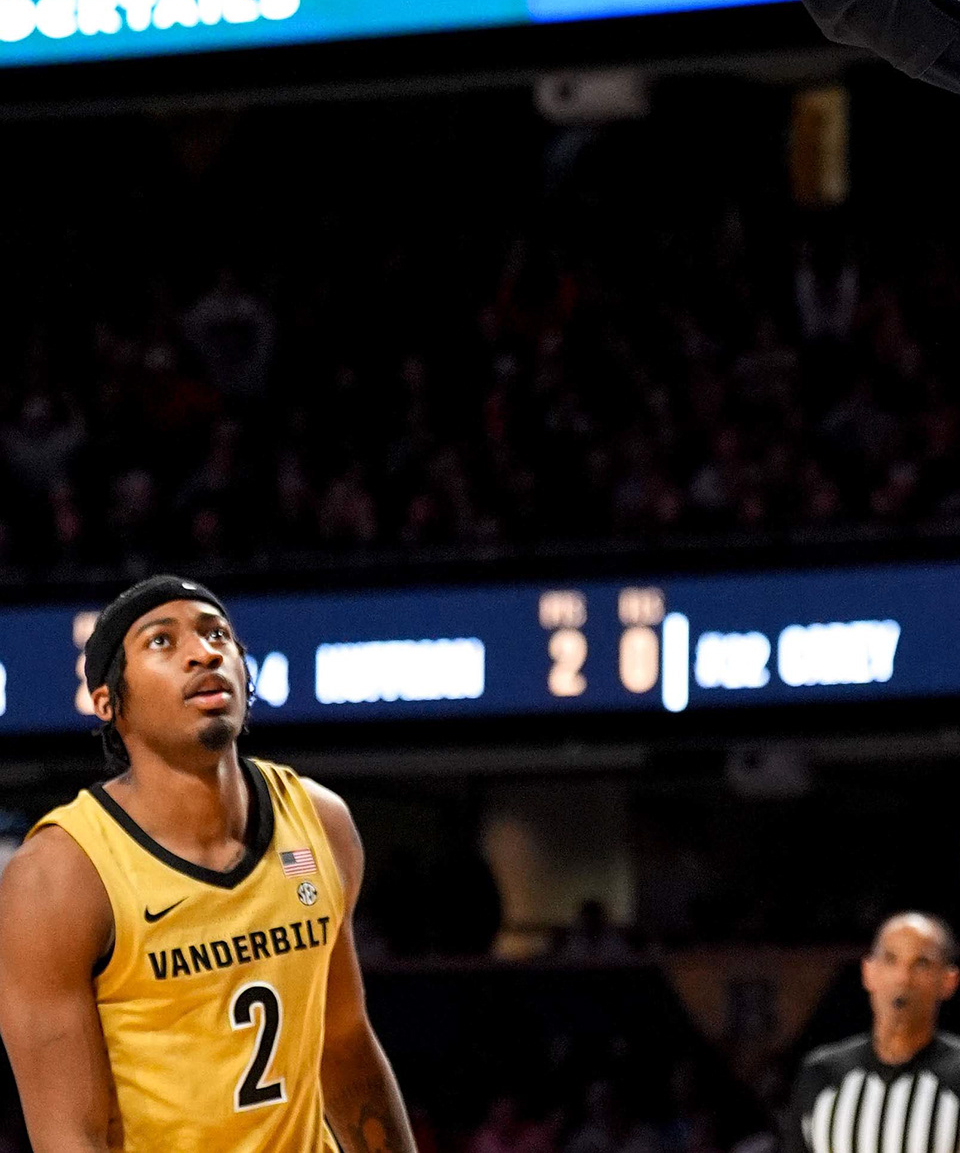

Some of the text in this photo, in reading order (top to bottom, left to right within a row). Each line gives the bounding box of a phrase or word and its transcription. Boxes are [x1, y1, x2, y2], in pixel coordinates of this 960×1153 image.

[548, 629, 587, 697] 2
[148, 916, 330, 980] VANDERBILT
[229, 981, 288, 1112] 2
